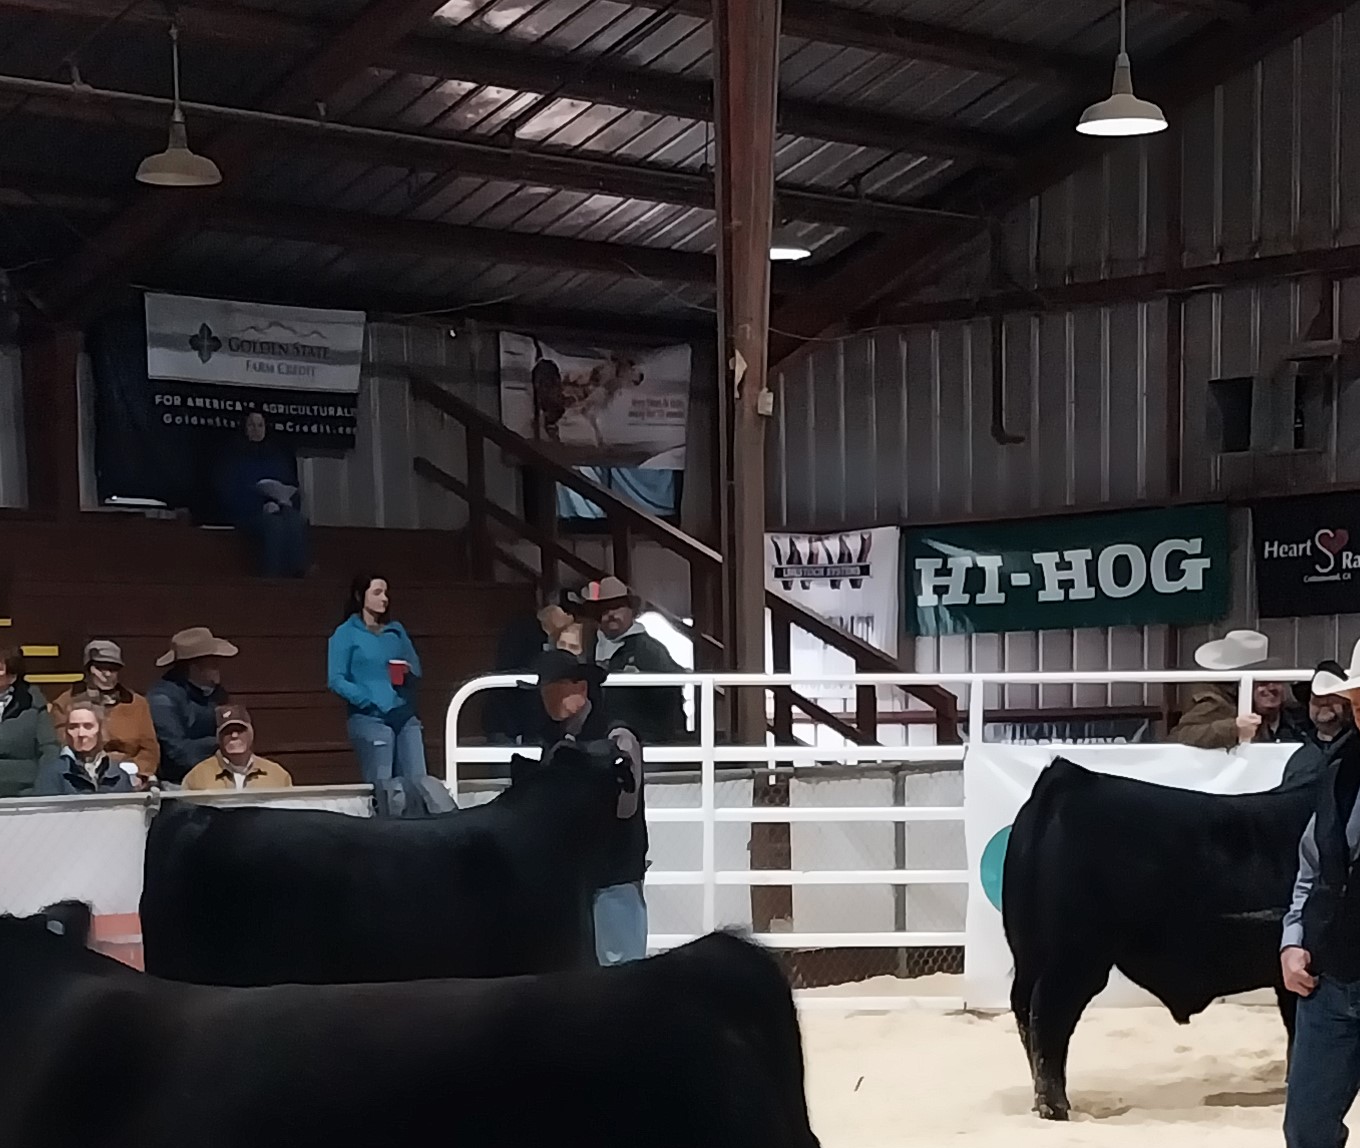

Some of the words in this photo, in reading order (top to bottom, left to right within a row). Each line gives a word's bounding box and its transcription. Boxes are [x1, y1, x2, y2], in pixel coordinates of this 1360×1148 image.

[228, 336, 289, 356] GOLDEN
[291, 342, 331, 360] STATE
[246, 359, 275, 374] FARM
[277, 361, 317, 377] CREDIT
[154, 395, 182, 407] FOR
[1263, 539, 1313, 560] Heart
[914, 537, 1212, 608] HI-HOG
